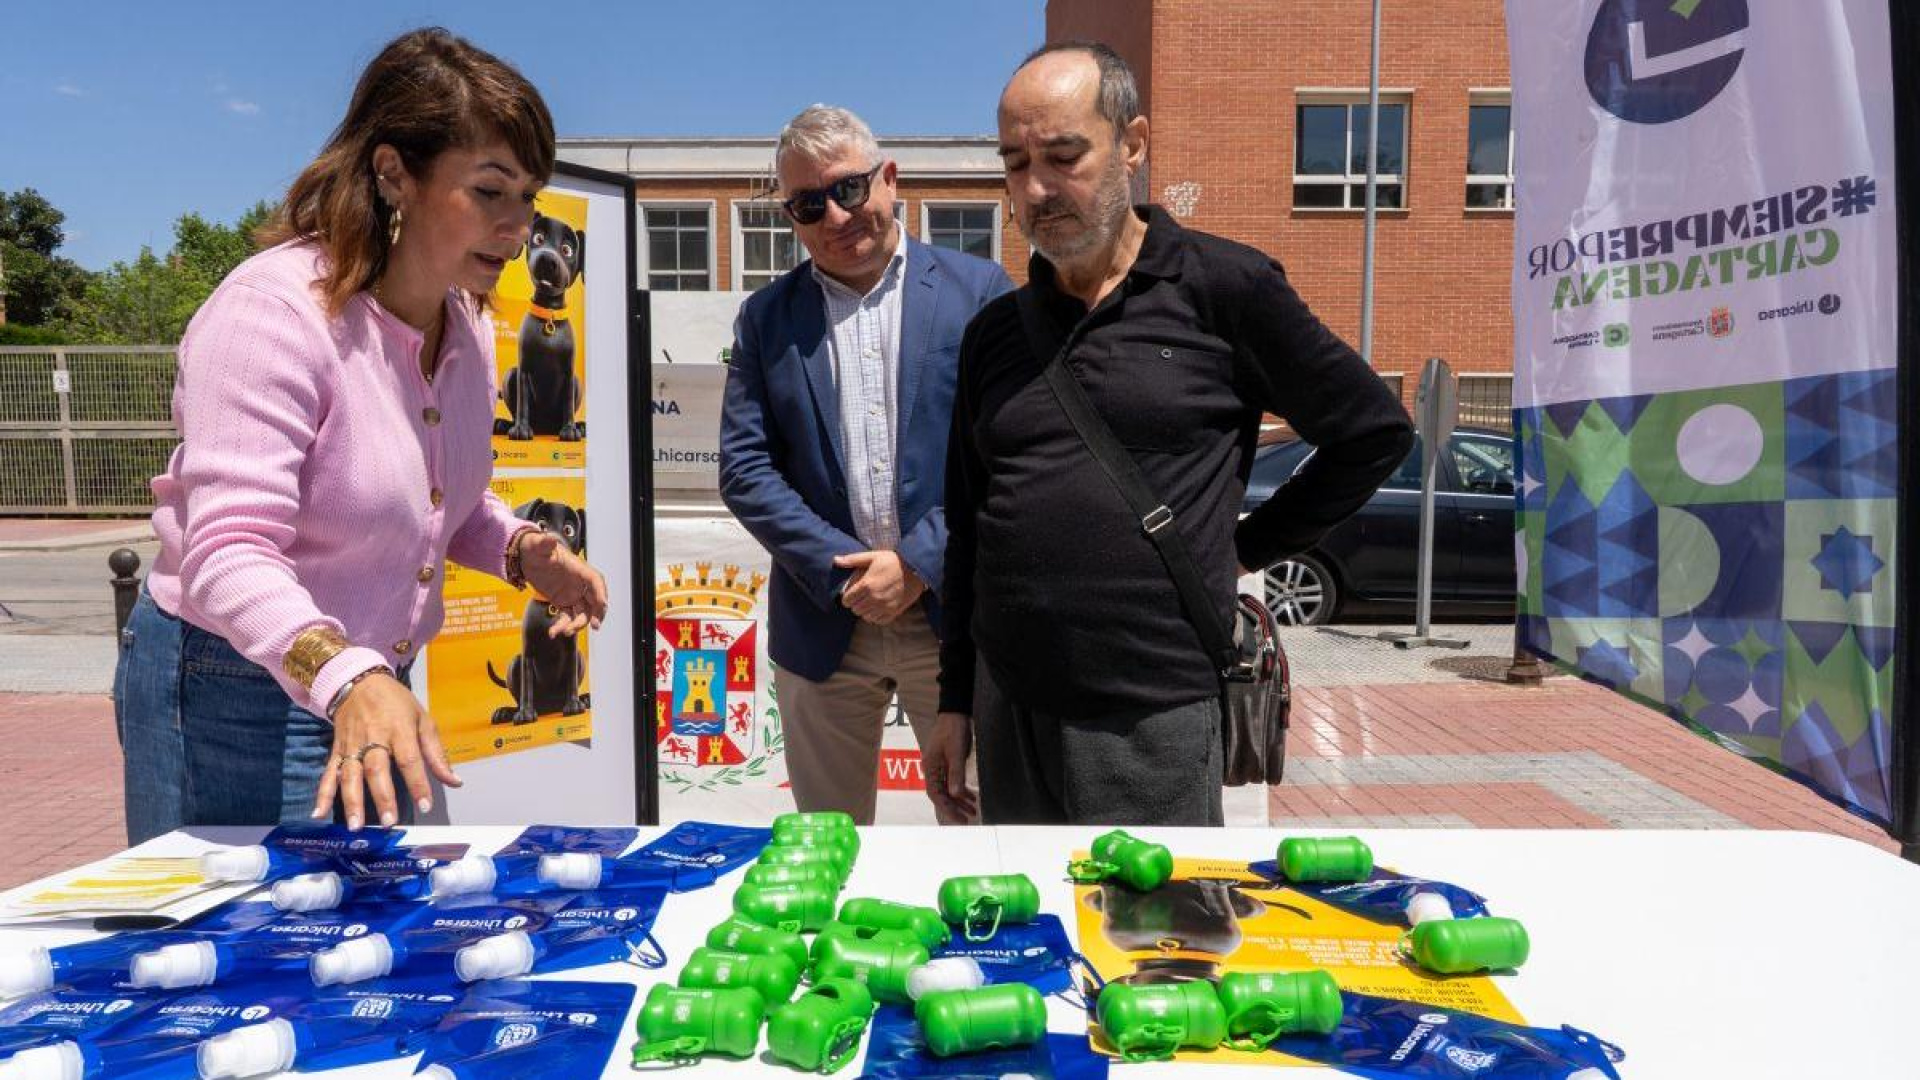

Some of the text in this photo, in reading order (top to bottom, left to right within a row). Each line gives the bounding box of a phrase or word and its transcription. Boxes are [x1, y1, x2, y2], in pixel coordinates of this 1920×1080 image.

[272, 925, 341, 935] Lhicarsa
[433, 919, 501, 930] Lhicarsa
[158, 1005, 240, 1017] Lhicarsa
